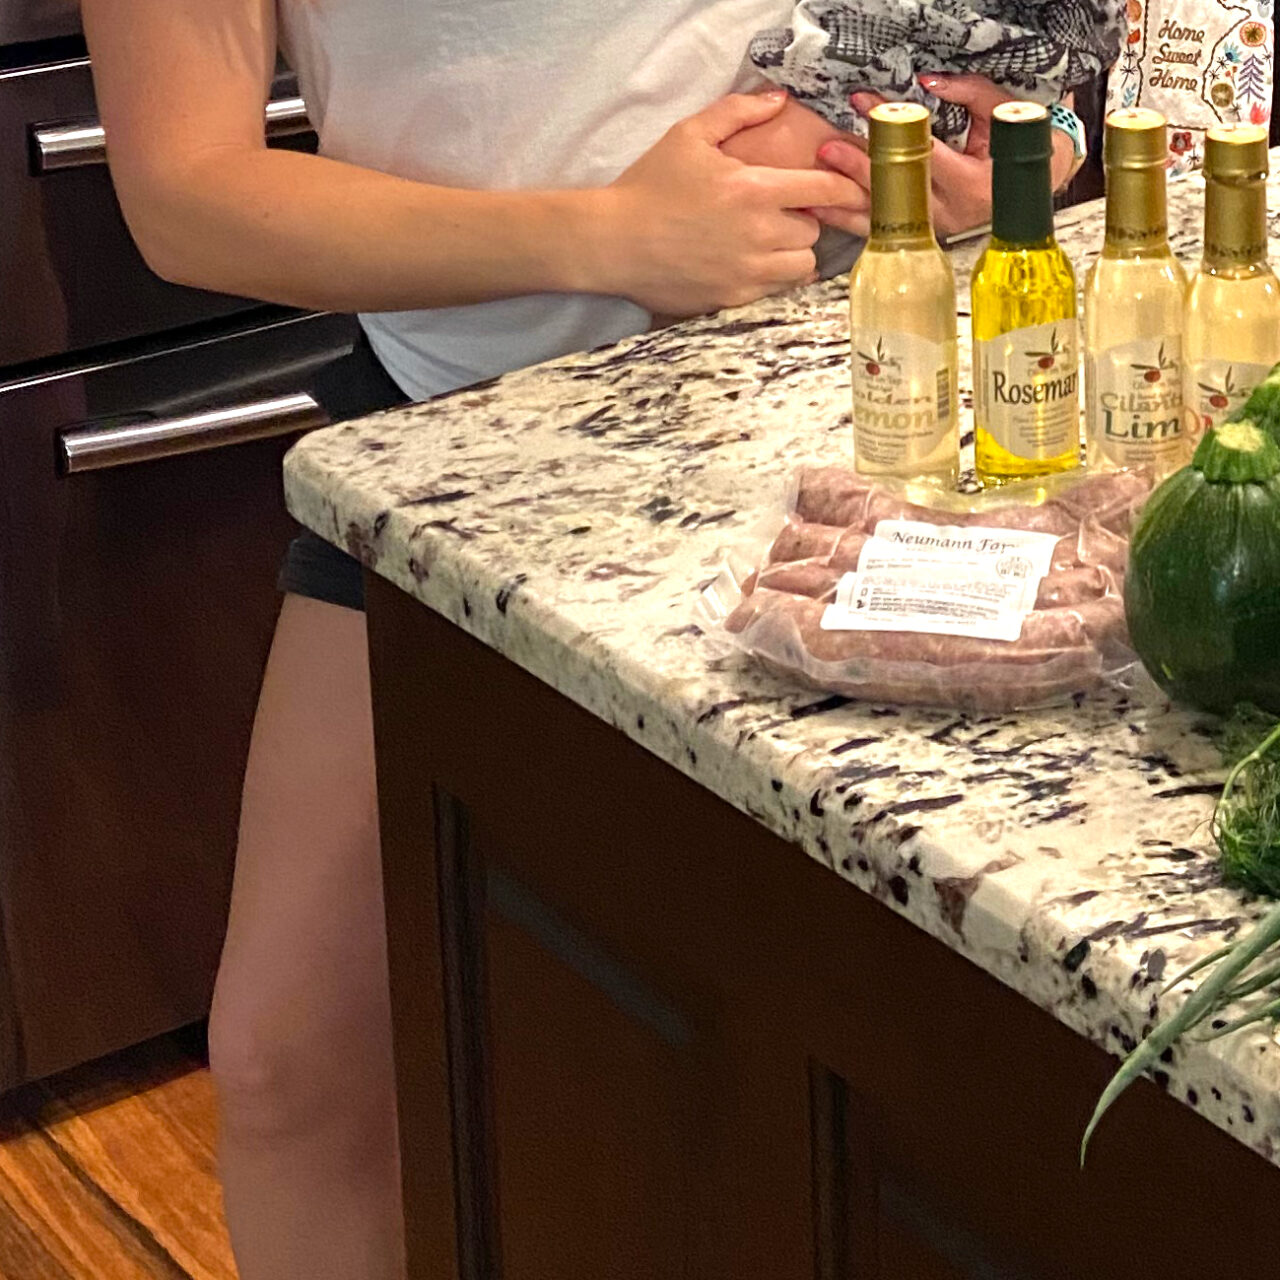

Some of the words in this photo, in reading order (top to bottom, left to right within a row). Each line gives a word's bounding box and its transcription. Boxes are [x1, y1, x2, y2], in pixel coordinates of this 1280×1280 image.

[1158, 19, 1205, 43] Home
[1152, 43, 1202, 67] Sweet
[1149, 68, 1198, 92] Home
[992, 370, 1077, 405] Rosemar
[1101, 408, 1181, 439] Lim
[892, 531, 972, 550] Neumann
